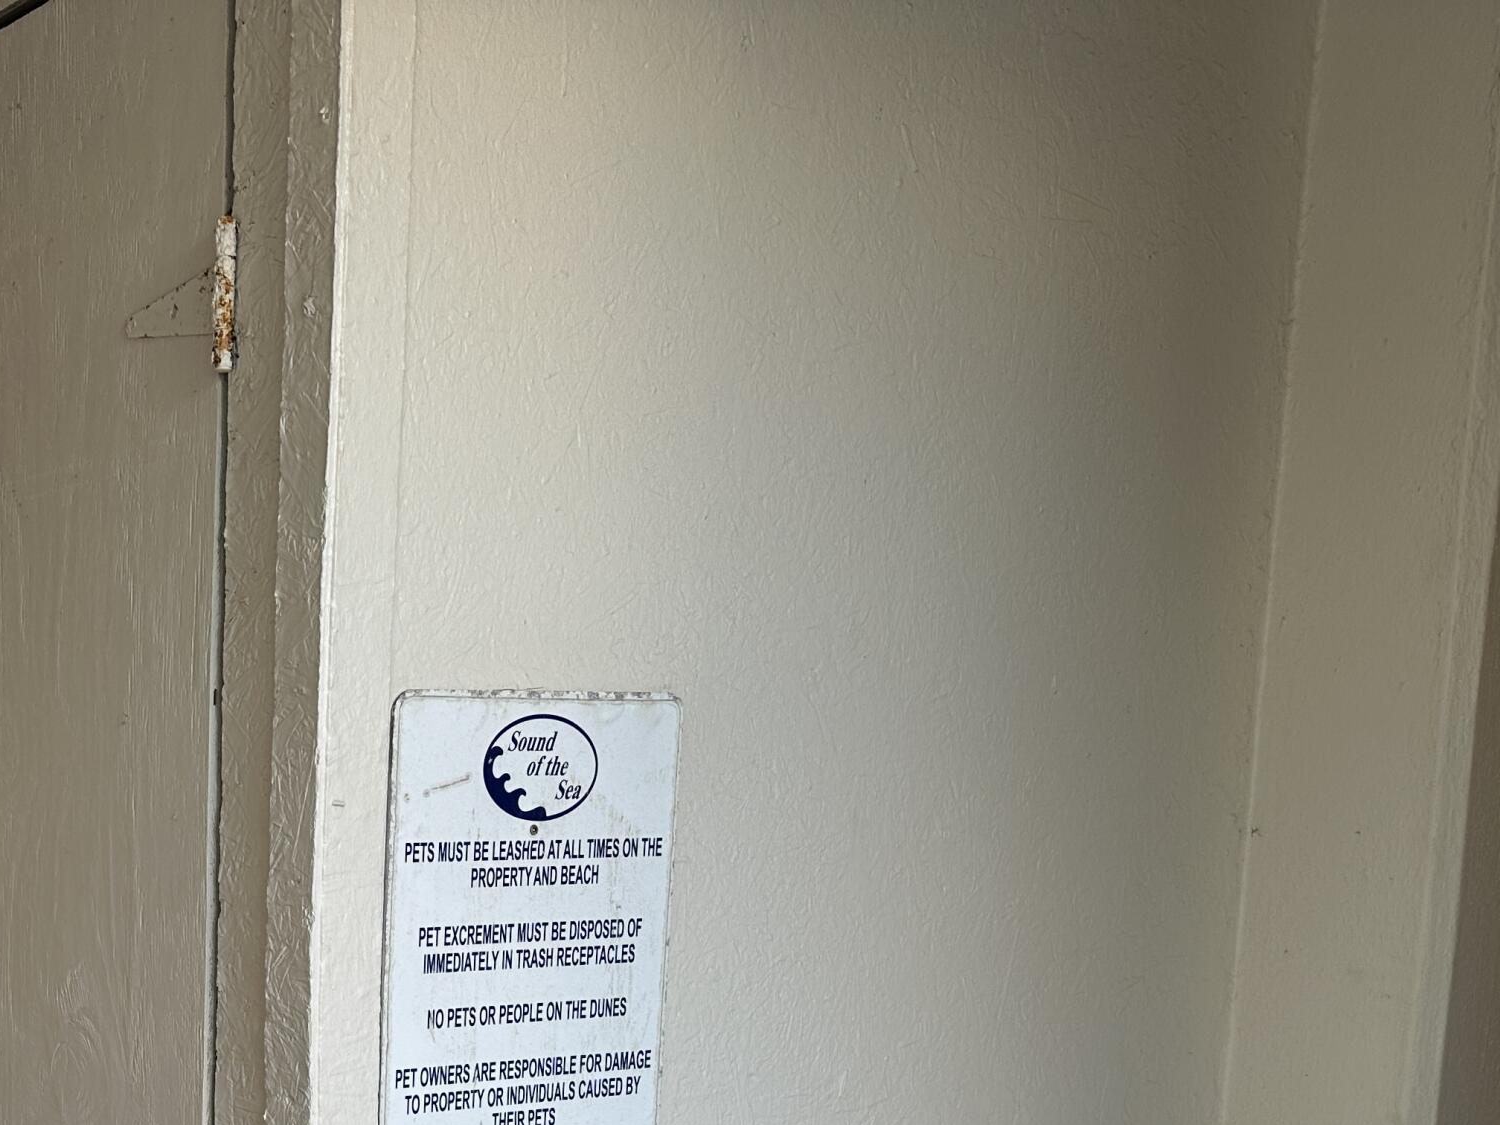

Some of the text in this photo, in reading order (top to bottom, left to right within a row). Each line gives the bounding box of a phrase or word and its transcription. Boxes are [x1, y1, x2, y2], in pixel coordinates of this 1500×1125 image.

[508, 730, 557, 751] Sound
[527, 756, 569, 777] of the
[555, 780, 581, 800] Sea
[405, 838, 663, 863] PETS MUST BE LEASHED AT ALL TIMES ON THE
[471, 865, 599, 888] PROPERTY AND BEACH
[419, 918, 642, 947] PET EXCREMENT MUST BE DISPOSED OF
[423, 944, 635, 974] IMMEDIATELY IN TRASH RECEPTACLES
[427, 997, 626, 1029] NO PETS OR PEOPLE ON THE DUNES
[395, 1050, 651, 1089] PET OWNERS ARE RESPONSIBLE FOR DAMAGE
[405, 1076, 640, 1115] TO PROPERTY OR INDIVIDUALS CAUSED BY
